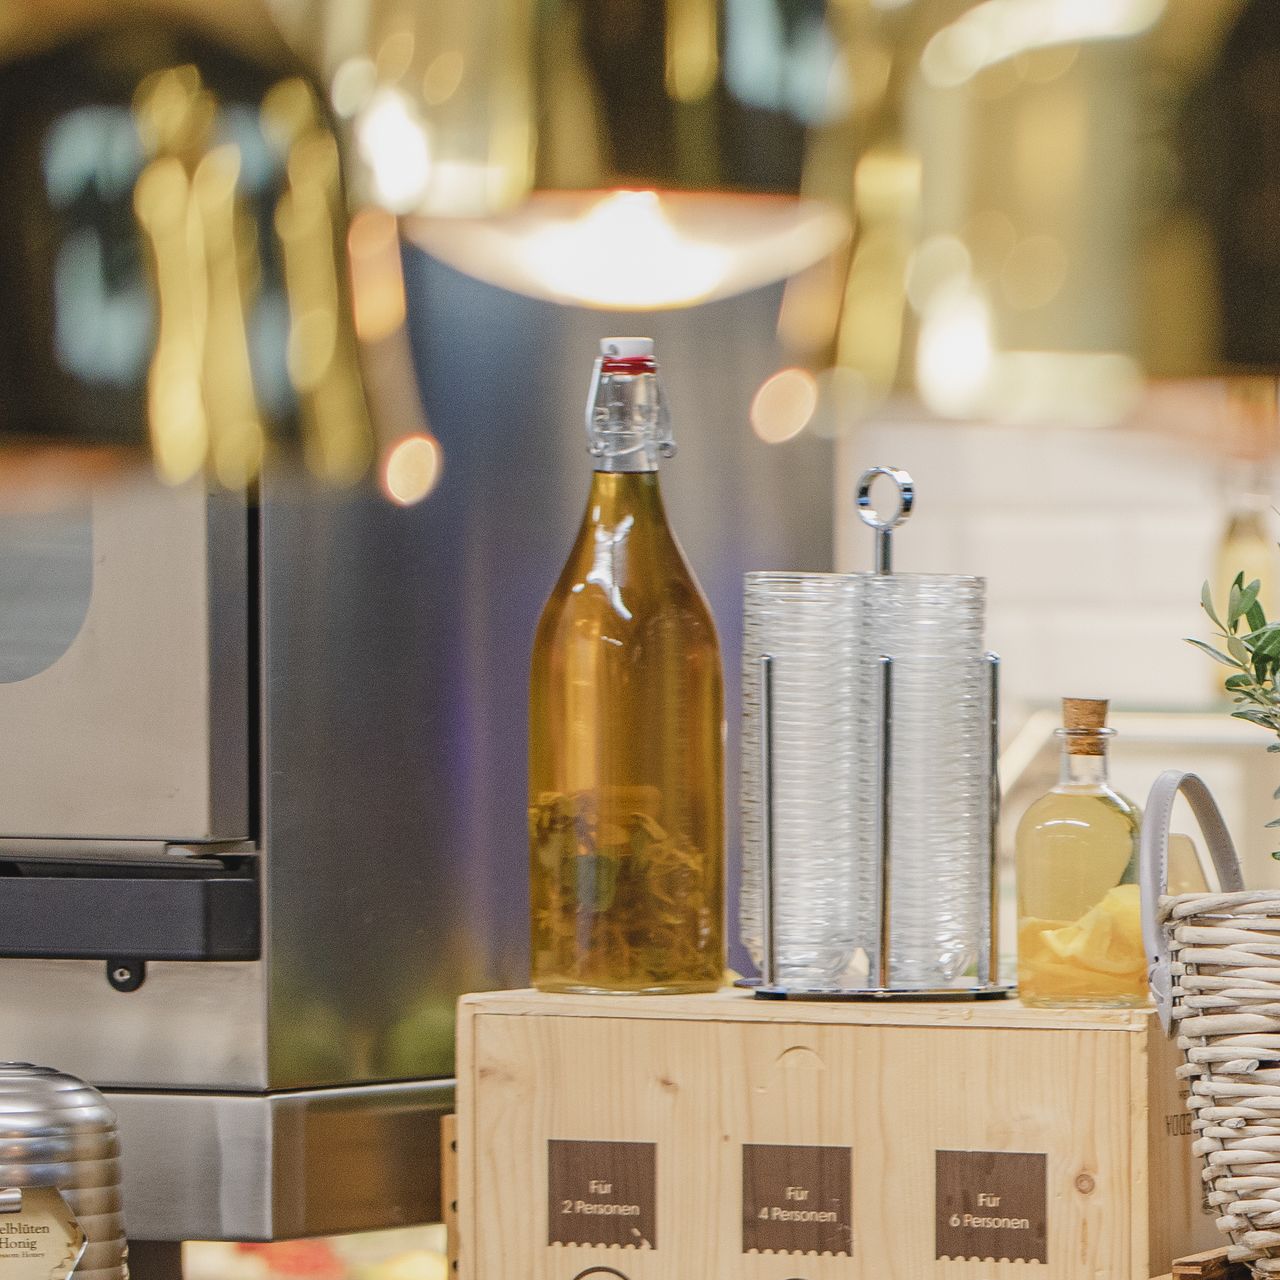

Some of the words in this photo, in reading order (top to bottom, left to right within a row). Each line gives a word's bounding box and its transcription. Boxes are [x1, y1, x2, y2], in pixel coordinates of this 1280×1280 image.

[588, 1180, 613, 1194] Für
[785, 1186, 809, 1201] Für
[561, 1199, 573, 1214] 2
[574, 1200, 640, 1216] Personen
[977, 1193, 1001, 1207] Für
[758, 1207, 769, 1220] 4
[771, 1207, 837, 1222] Personen
[949, 1214, 961, 1227] 6
[963, 1213, 1030, 1229] Personen
[0, 1237, 37, 1250] Honig
